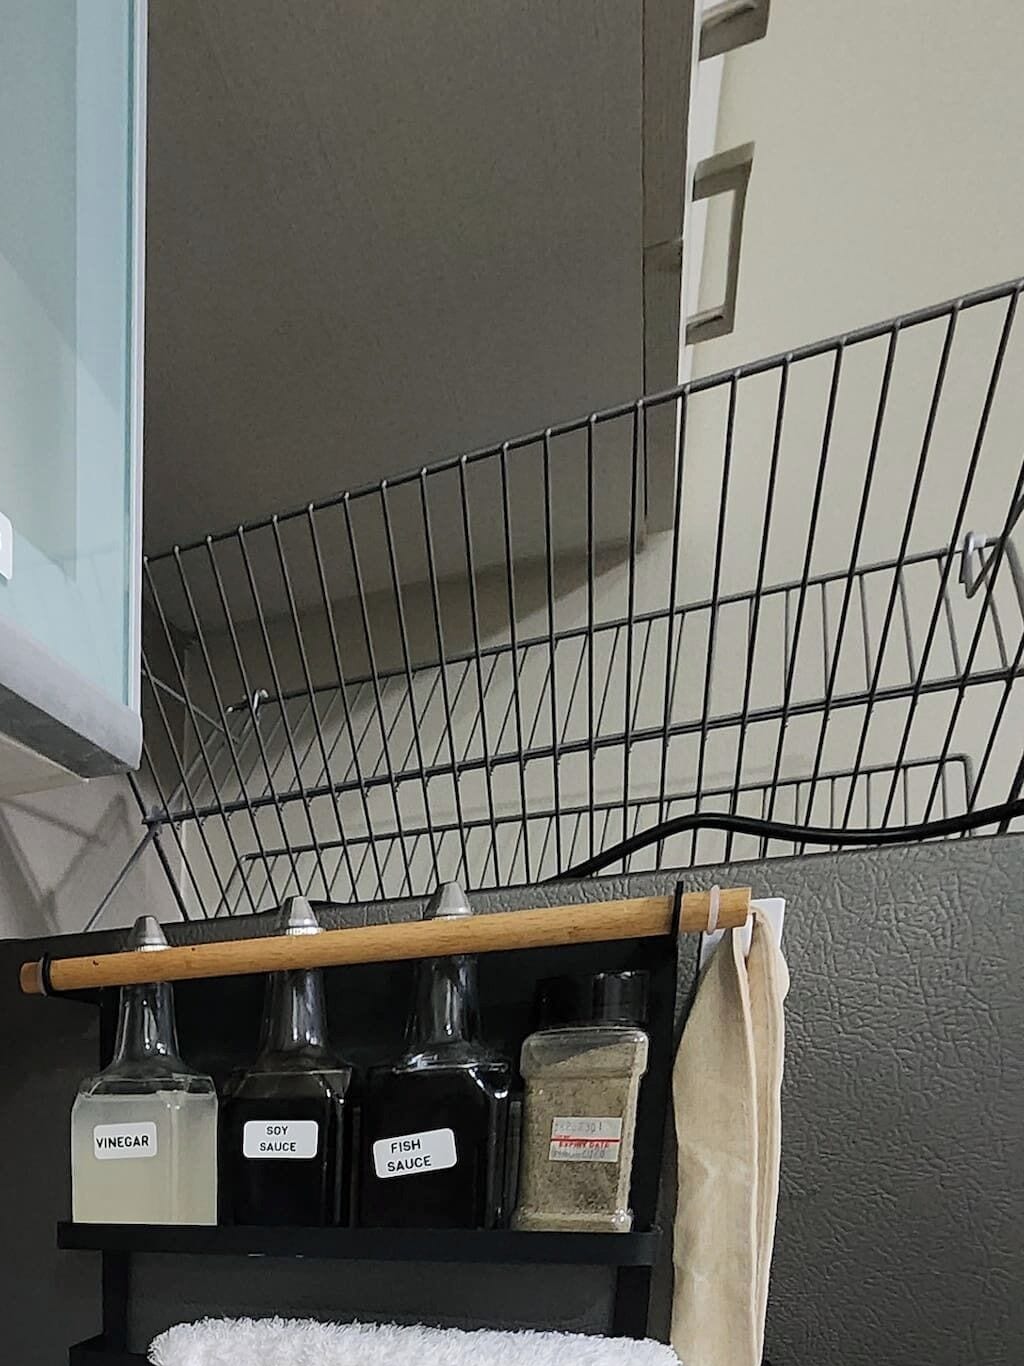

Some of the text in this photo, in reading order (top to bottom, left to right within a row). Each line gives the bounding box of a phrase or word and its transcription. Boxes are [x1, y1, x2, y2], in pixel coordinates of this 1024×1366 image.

[266, 1126, 289, 1136] SOY
[96, 1136, 149, 1149] VINEGAR
[259, 1142, 297, 1152] SAUCE
[390, 1139, 421, 1153] FISH
[387, 1156, 431, 1172] SAUCE
